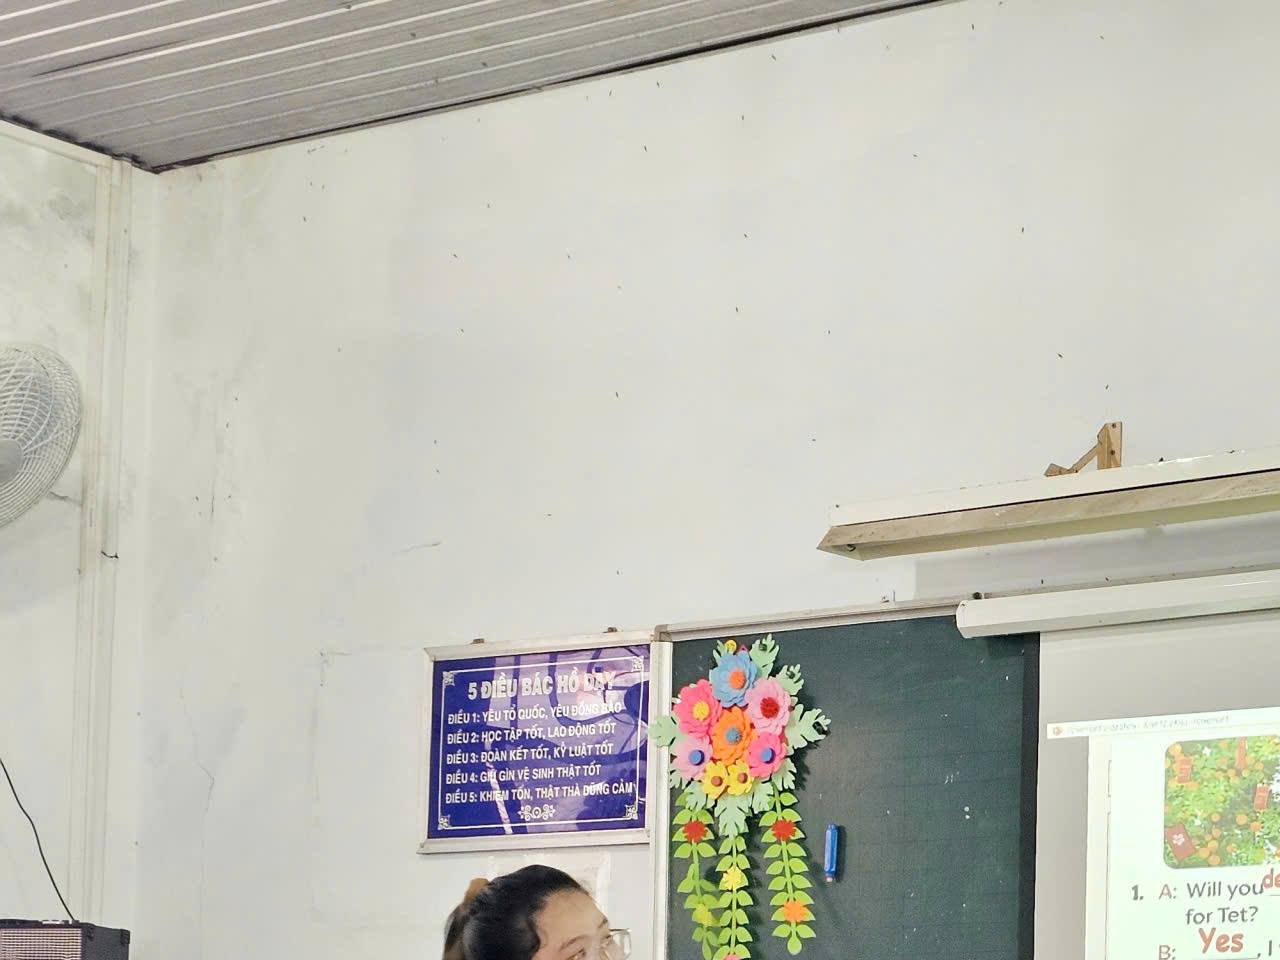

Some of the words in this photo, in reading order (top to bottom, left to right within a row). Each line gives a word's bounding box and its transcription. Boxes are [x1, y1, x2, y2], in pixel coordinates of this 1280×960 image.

[468, 683, 478, 700] 5
[481, 673, 518, 699] ĐIỀU
[522, 672, 553, 695] BÁC
[448, 709, 470, 725] ĐIỀU
[472, 712, 480, 723] 1:
[482, 707, 501, 722] YÊU
[503, 703, 517, 720] TỔ
[517, 703, 549, 720] QUỐC,
[550, 703, 569, 718] YÊU
[447, 730, 470, 744] ĐIỀU
[471, 732, 479, 743] 2:
[481, 729, 502, 743] HỌC
[503, 725, 522, 742] TẬP
[547, 726, 567, 738] LAO
[568, 722, 596, 738] ĐỘNG
[598, 719, 616, 735] TỐT
[447, 750, 469, 765] ĐIỀU
[470, 753, 479, 764] 3:
[481, 747, 507, 763] ĐOÀN
[509, 746, 528, 761] KẾT
[569, 744, 593, 758] LUẬT
[595, 740, 614, 755] TỐT
[446, 769, 468, 785] ĐIỀU
[470, 773, 478, 783] 4:
[499, 767, 515, 781] GÌN
[517, 766, 530, 781] VỆ
[532, 766, 554, 779] SINH
[556, 763, 581, 778] THẬT
[583, 761, 602, 776] TỐT
[445, 789, 467, 804] ĐIỀU
[469, 792, 478, 802] 5:
[536, 784, 561, 799] THẬT
[562, 782, 581, 797] THÀ
[612, 779, 633, 794] CẢM
[1131, 884, 1144, 900] 1.
[1158, 883, 1177, 899] A:
[1186, 881, 1222, 899] Will
[1228, 884, 1263, 903] you
[1185, 907, 1213, 925] for
[1217, 906, 1258, 923] Tet?
[1158, 944, 1177, 960] B:
[1199, 927, 1244, 955] Yes
